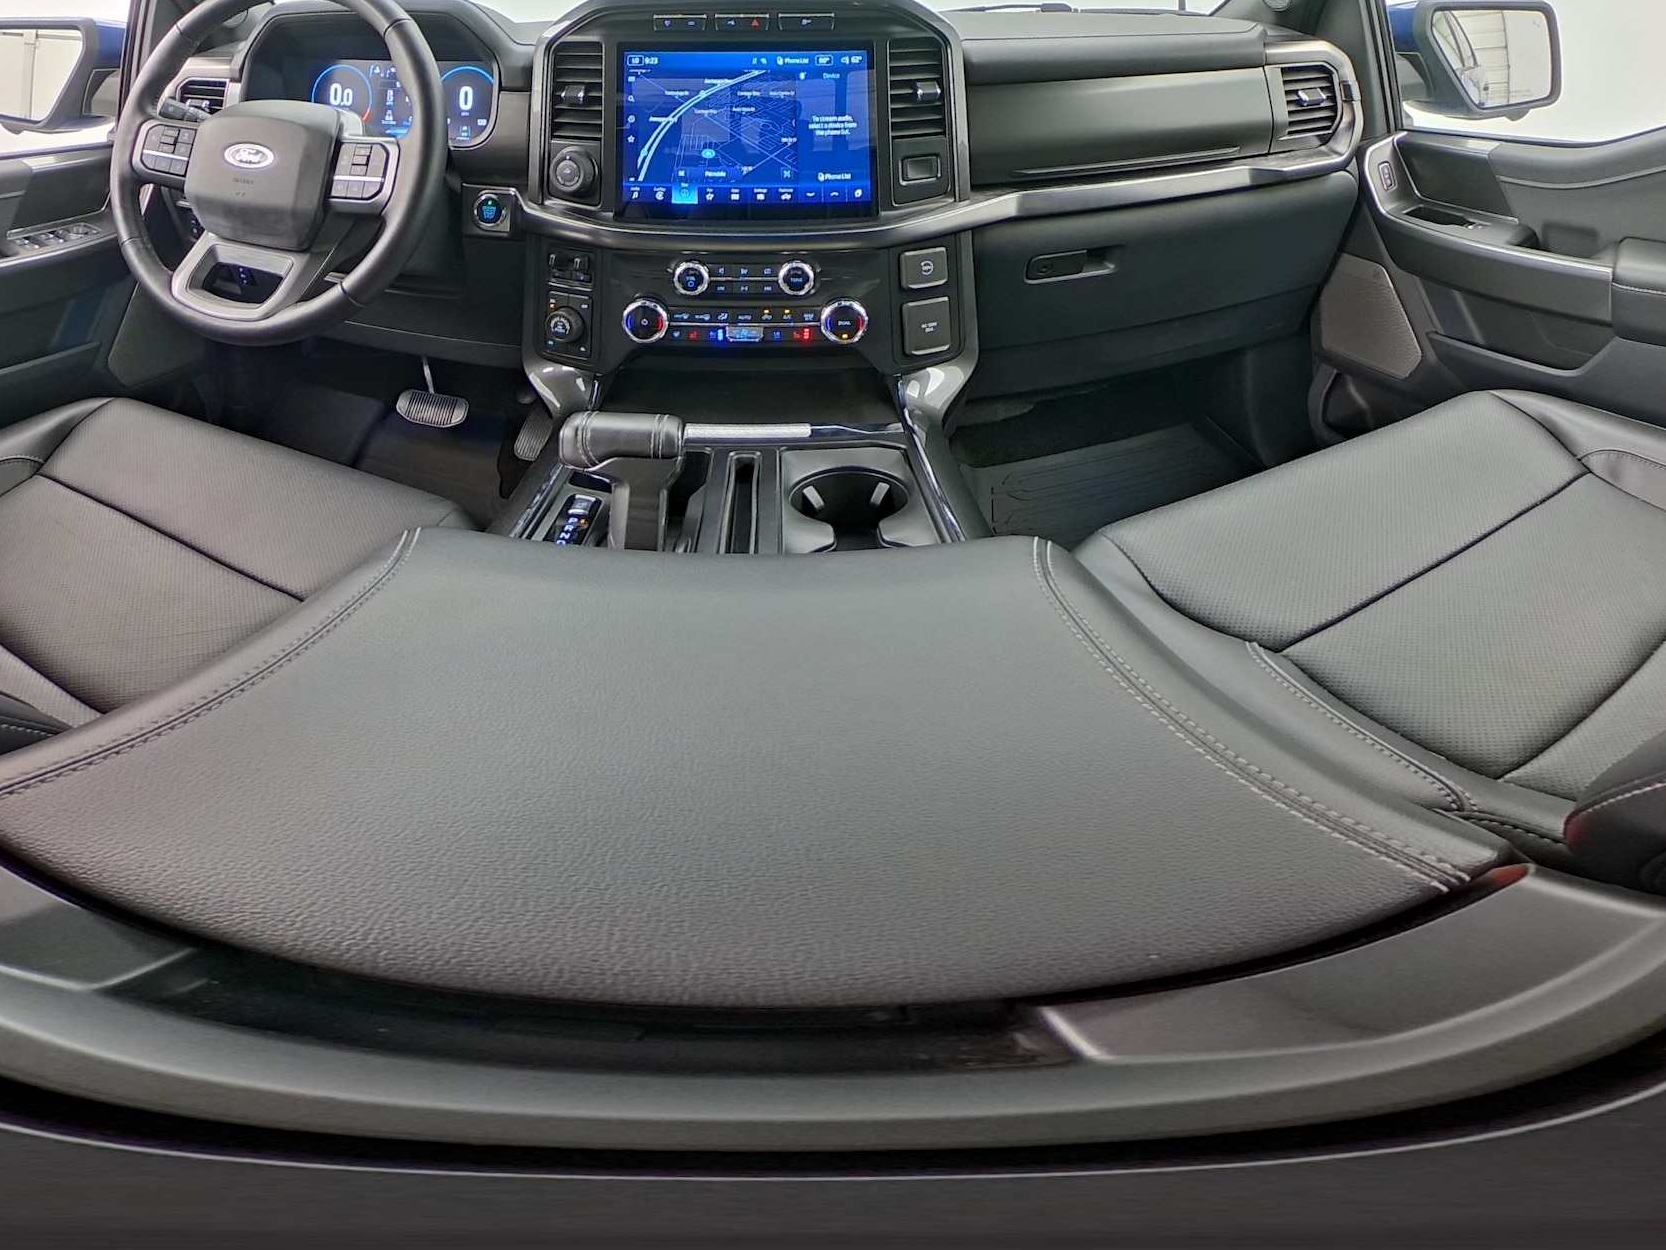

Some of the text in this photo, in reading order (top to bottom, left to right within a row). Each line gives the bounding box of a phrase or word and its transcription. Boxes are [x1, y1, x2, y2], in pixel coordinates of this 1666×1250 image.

[644, 57, 659, 65] 9:23
[329, 82, 354, 107] 0.0
[459, 85, 473, 111] 0
[825, 172, 852, 180] Phone List
[564, 524, 575, 532] R
[559, 532, 571, 540] N
